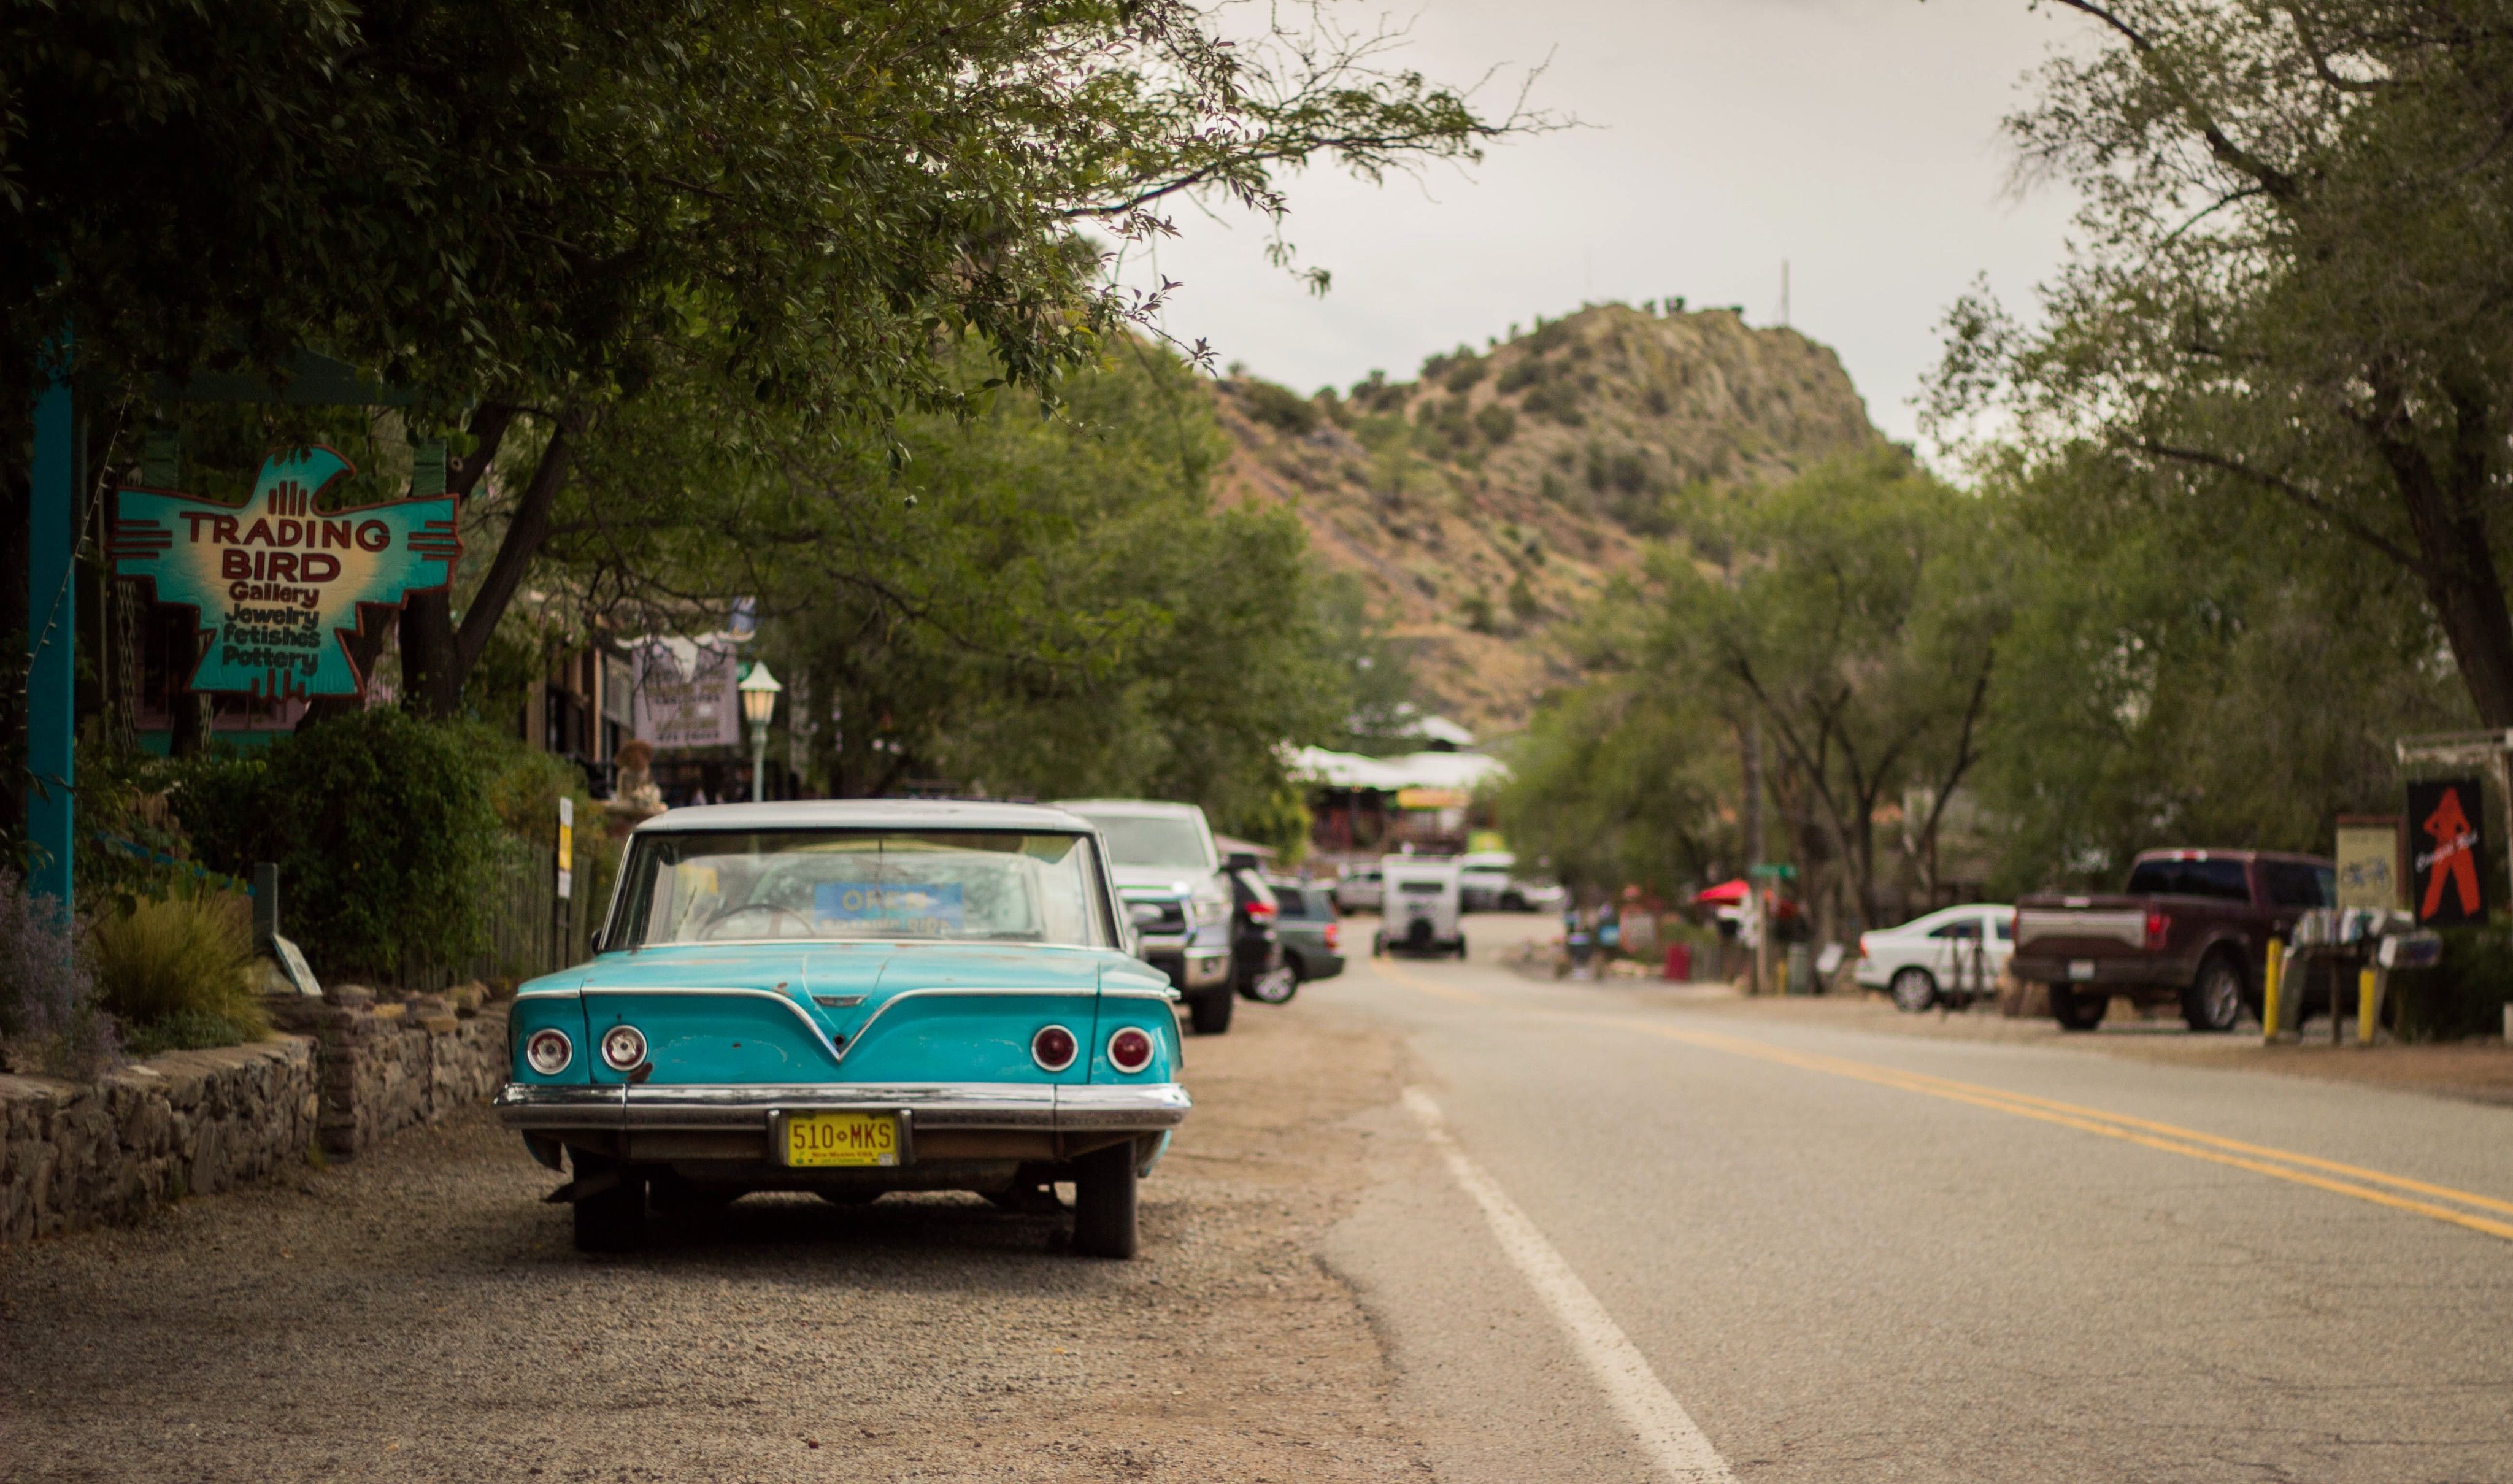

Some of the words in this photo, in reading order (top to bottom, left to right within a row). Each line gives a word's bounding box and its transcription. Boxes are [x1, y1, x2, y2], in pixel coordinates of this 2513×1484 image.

[179, 511, 390, 552] TRADING
[222, 548, 341, 582] BIRD
[229, 581, 320, 609] Gallery
[225, 603, 320, 631] Jewelry
[222, 645, 318, 676] Pottery
[793, 1124, 834, 1149] 510
[850, 1123, 890, 1149] MKS
